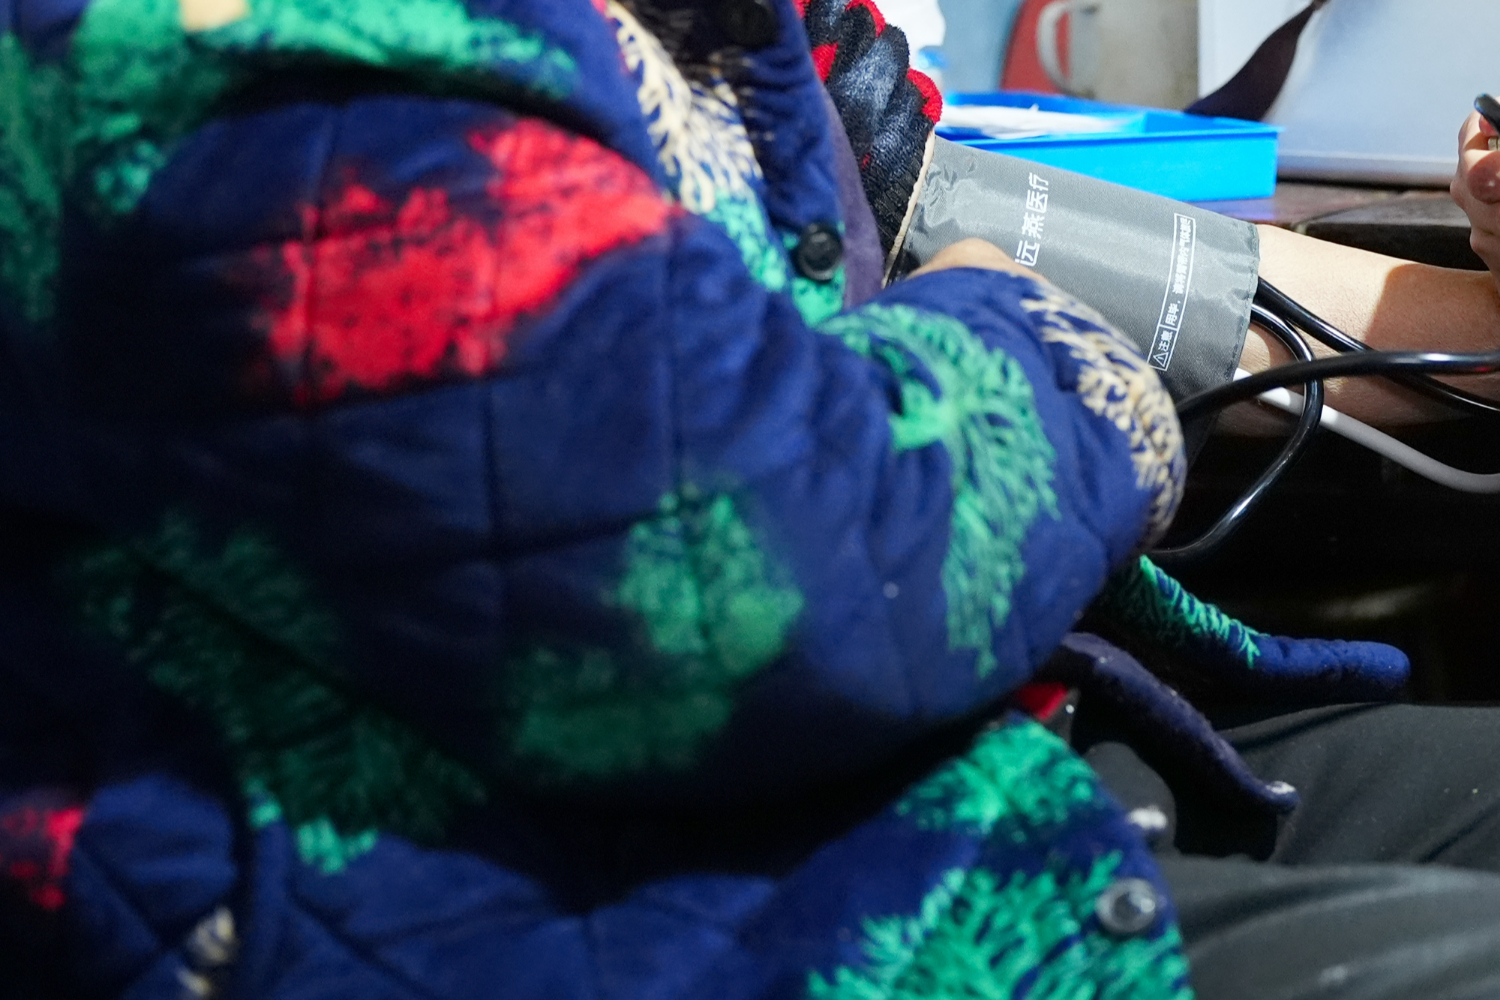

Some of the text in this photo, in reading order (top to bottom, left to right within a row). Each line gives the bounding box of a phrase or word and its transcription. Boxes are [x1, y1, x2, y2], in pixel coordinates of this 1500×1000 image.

[1014, 172, 1050, 267] 远燕医疗
[1157, 330, 1174, 352] 注意
